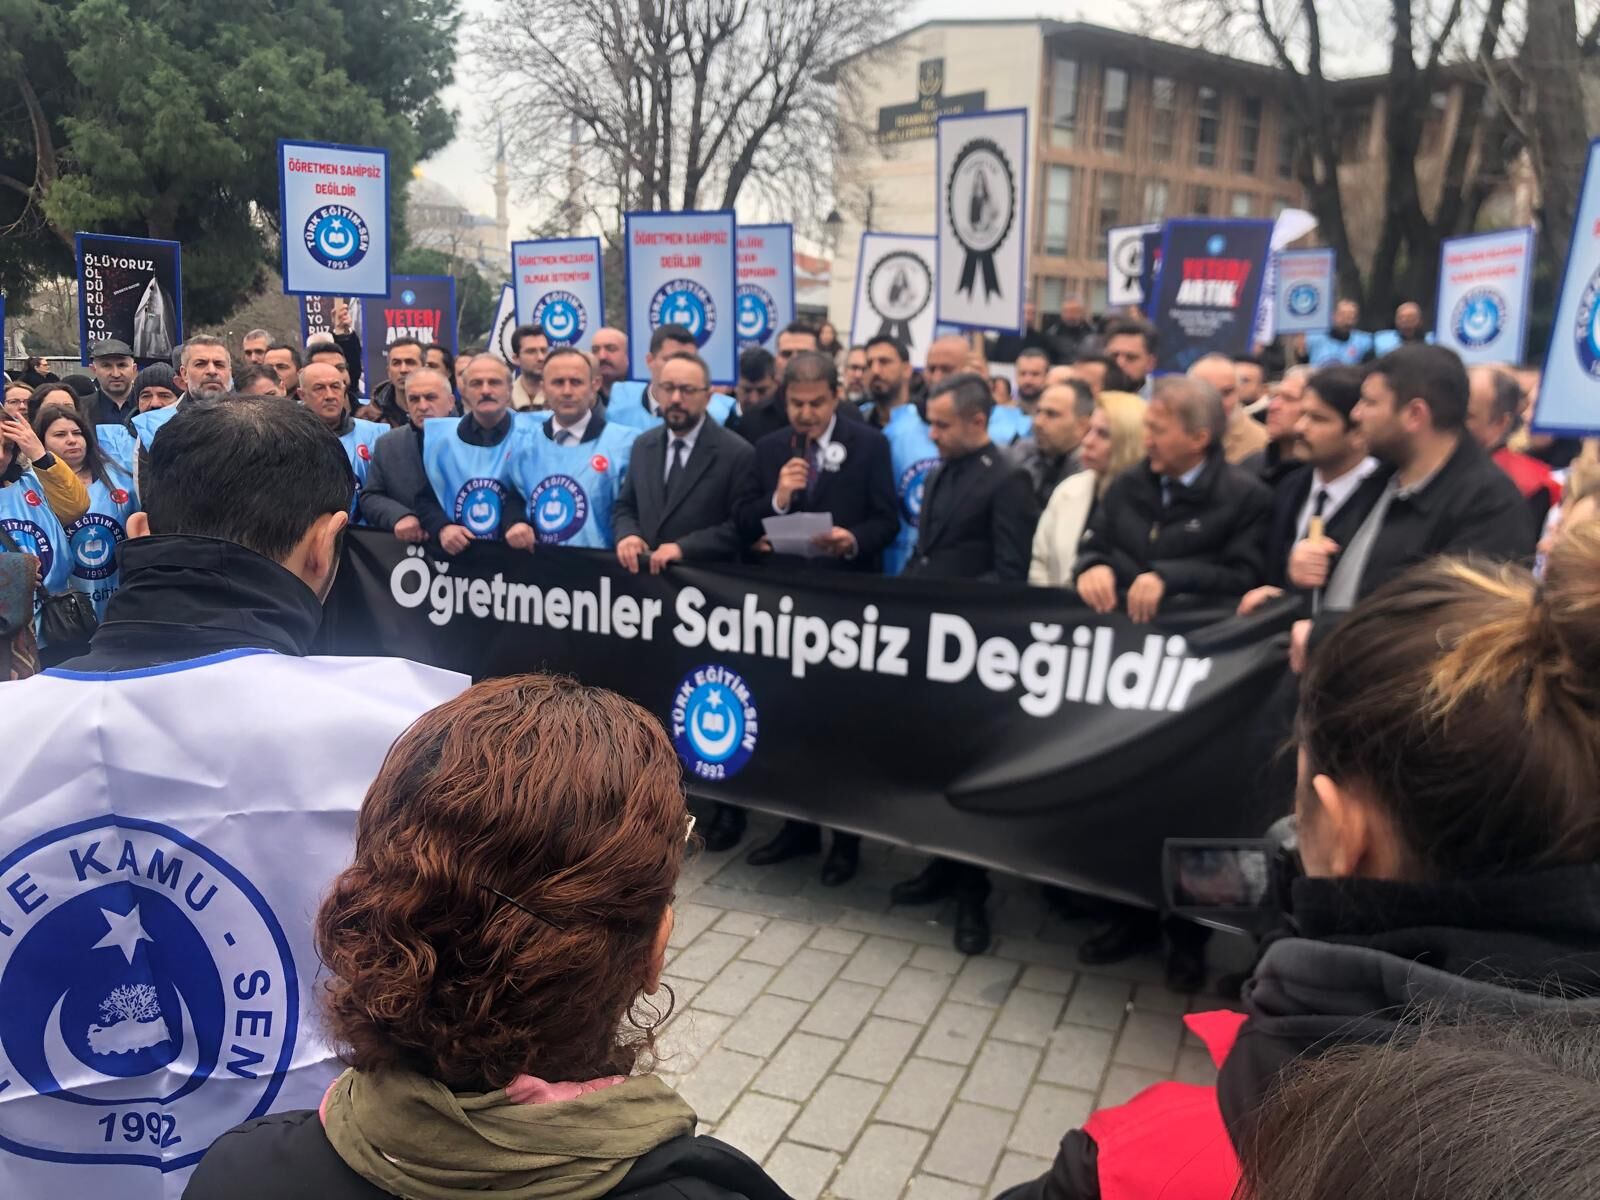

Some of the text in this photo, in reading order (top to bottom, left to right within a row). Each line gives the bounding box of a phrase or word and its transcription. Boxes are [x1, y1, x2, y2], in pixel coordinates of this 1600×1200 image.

[288, 157, 381, 178] ÖĞRETMEN SAHİPSİZ
[315, 182, 356, 196] DEĞİLDİR
[304, 205, 369, 252] TÜRK EĞİTİM-SEN
[84, 253, 154, 272] ÖLÜYORUZ
[327, 259, 349, 269] 1992
[85, 266, 103, 279] ÖL
[86, 279, 104, 291] DÜ
[86, 291, 104, 304] RÜ
[87, 304, 104, 317] LÜ
[87, 318, 105, 329] YO
[308, 314, 323, 324] YO
[390, 545, 1212, 717] Öğretmenler Sahipsiz Değildir
[672, 665, 758, 752] TÜRK EĞİTİM-SEN
[695, 760, 725, 779] 1992
[69, 839, 219, 912] KAMU
[226, 969, 273, 1080] SEN
[98, 1110, 182, 1149] 1992
